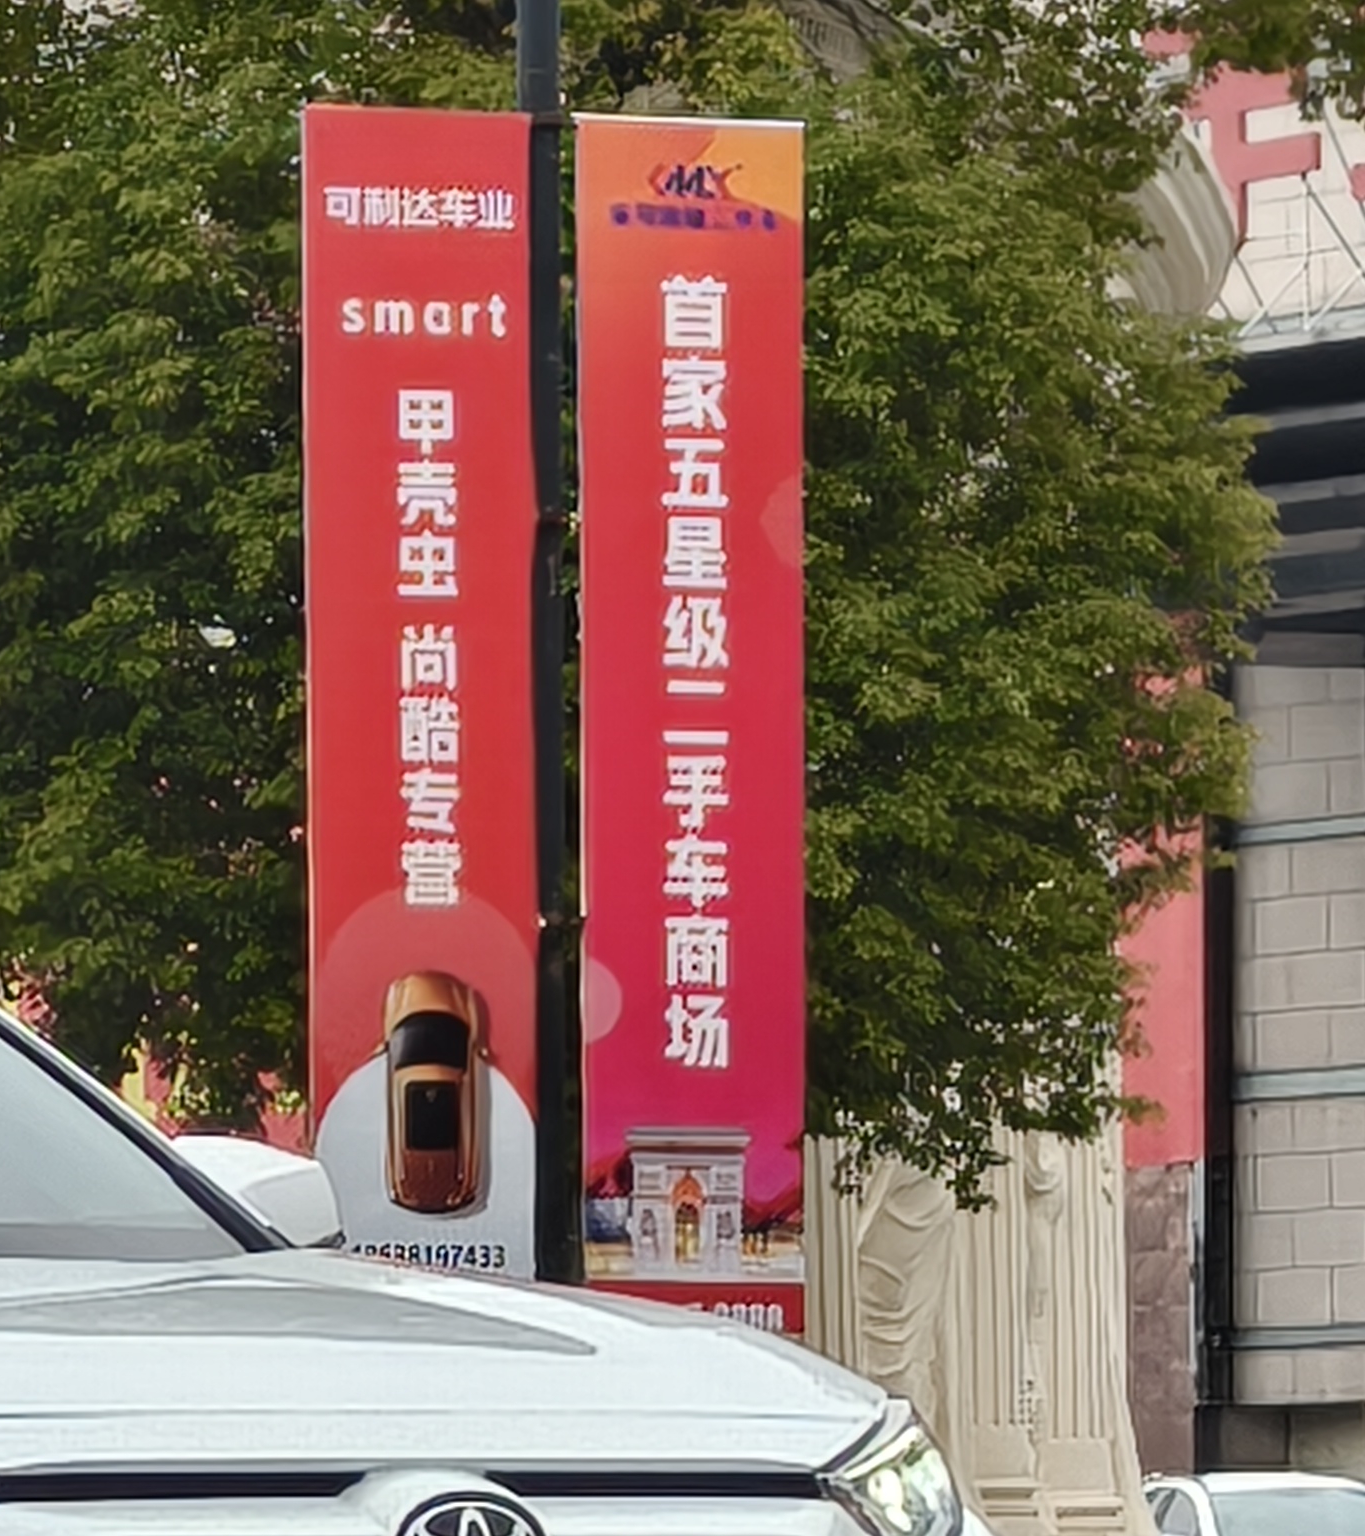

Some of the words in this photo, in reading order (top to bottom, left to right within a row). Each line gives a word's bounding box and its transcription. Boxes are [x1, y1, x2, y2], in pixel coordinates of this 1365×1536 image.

[324, 186, 515, 229] 可利达车业
[342, 294, 507, 337] smart
[397, 389, 459, 597] 甲壳虫
[399, 624, 462, 906] 尚酷专营
[660, 274, 730, 1069] 首家五星级二手车商场
